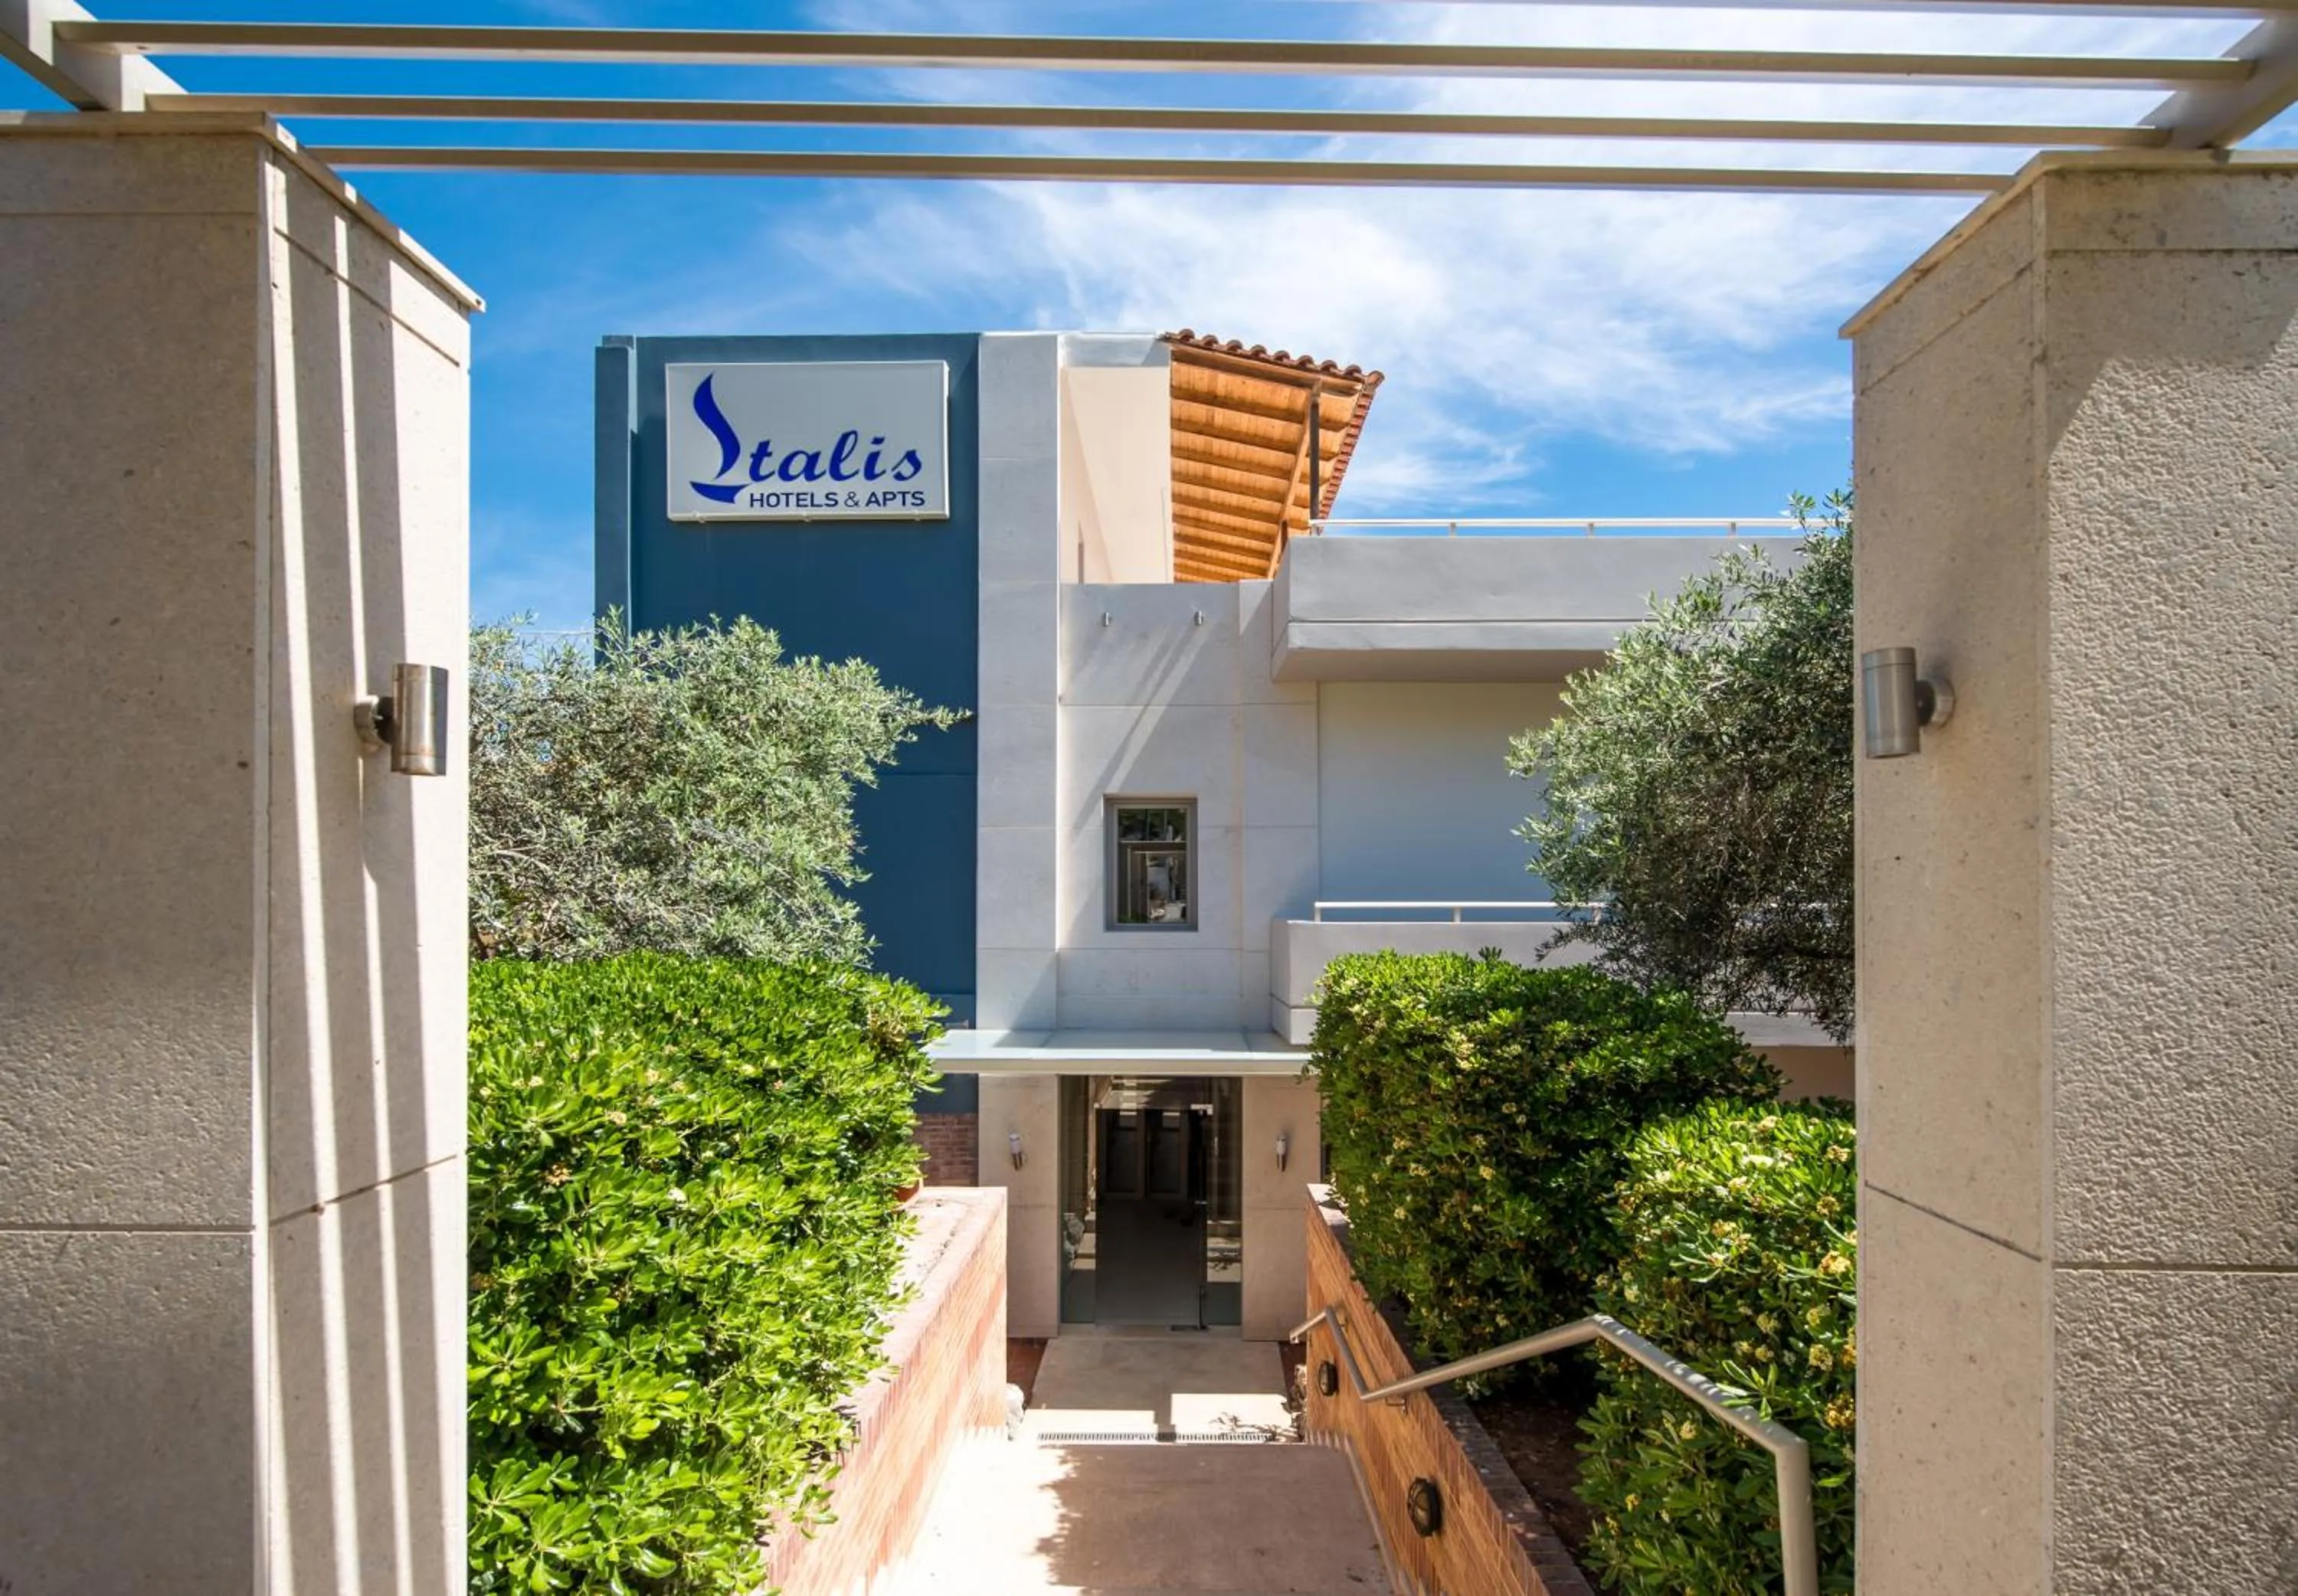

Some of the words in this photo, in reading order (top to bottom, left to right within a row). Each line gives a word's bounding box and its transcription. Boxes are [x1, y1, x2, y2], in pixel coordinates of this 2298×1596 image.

[750, 492, 839, 508] HOTELS
[844, 491, 860, 507] &
[866, 491, 925, 507] APTS
